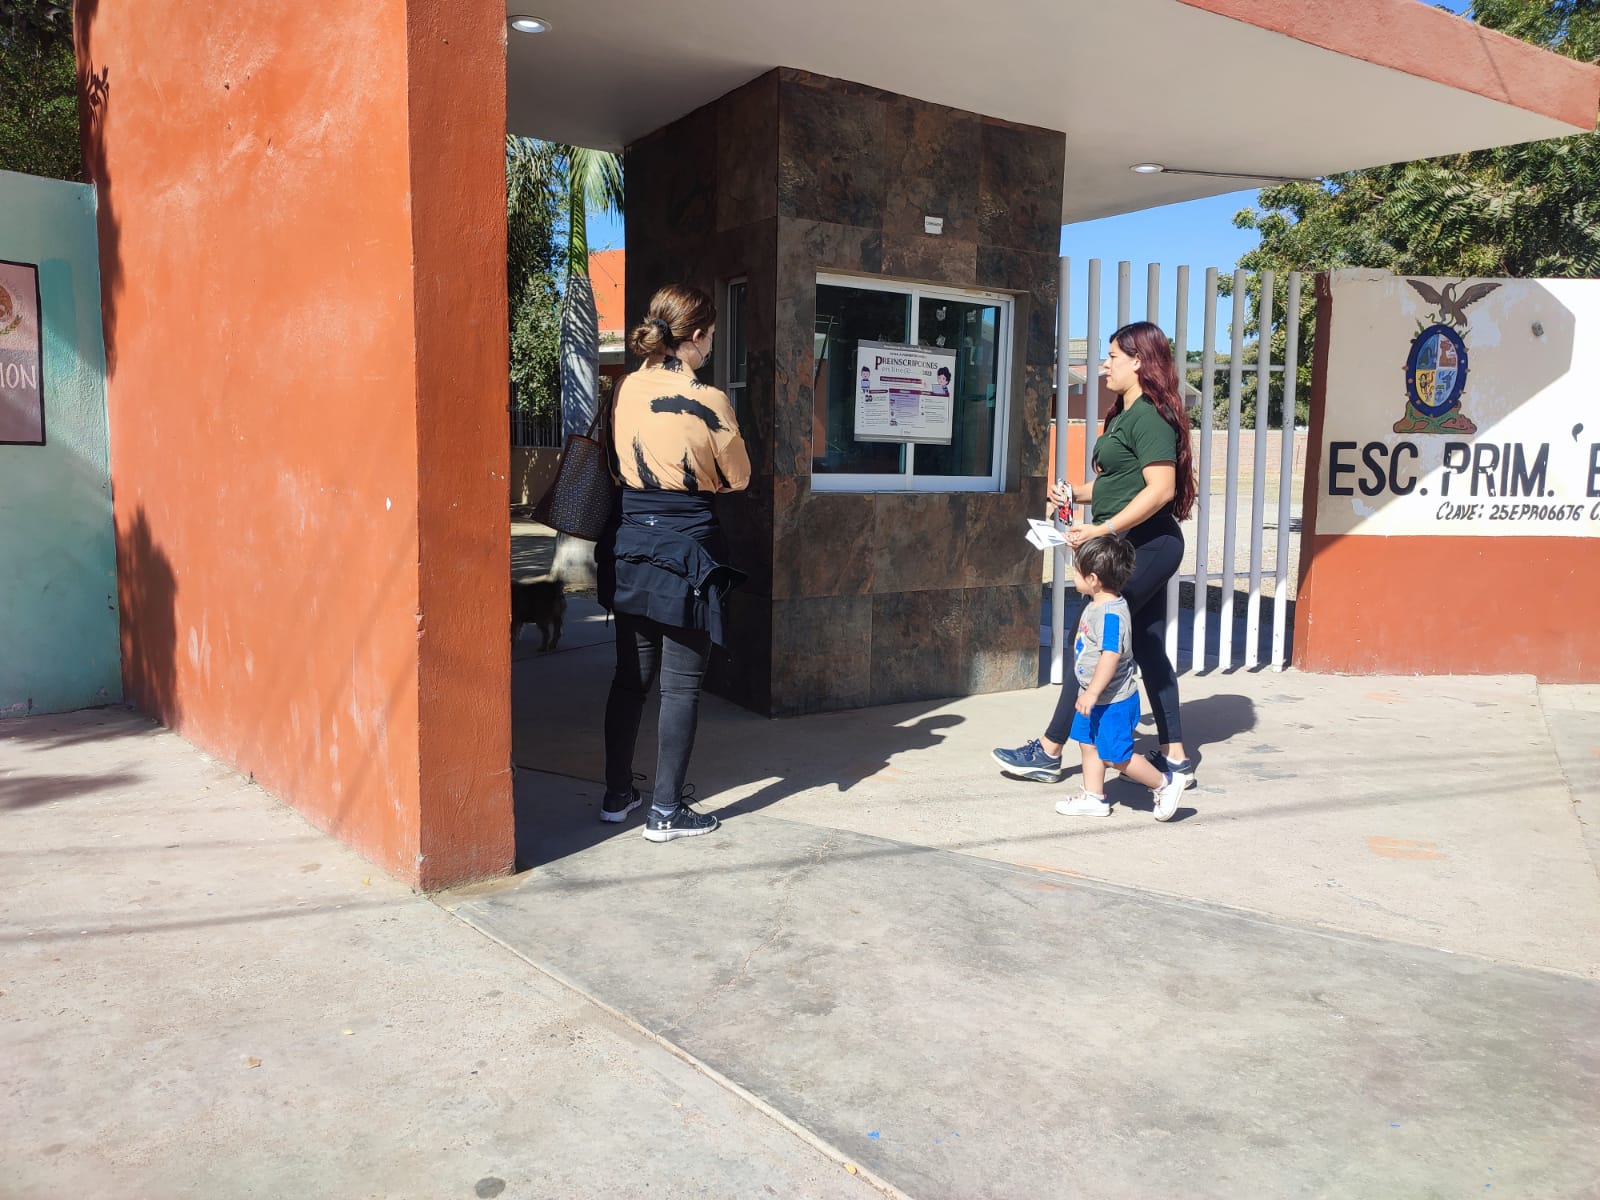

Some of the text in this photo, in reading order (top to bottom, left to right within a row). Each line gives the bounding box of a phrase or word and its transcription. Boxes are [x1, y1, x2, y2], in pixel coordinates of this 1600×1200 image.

[1328, 441, 1428, 496] ESC.
[1440, 442, 1555, 497] PRIM.
[1436, 501, 1484, 520] CLAVE:
